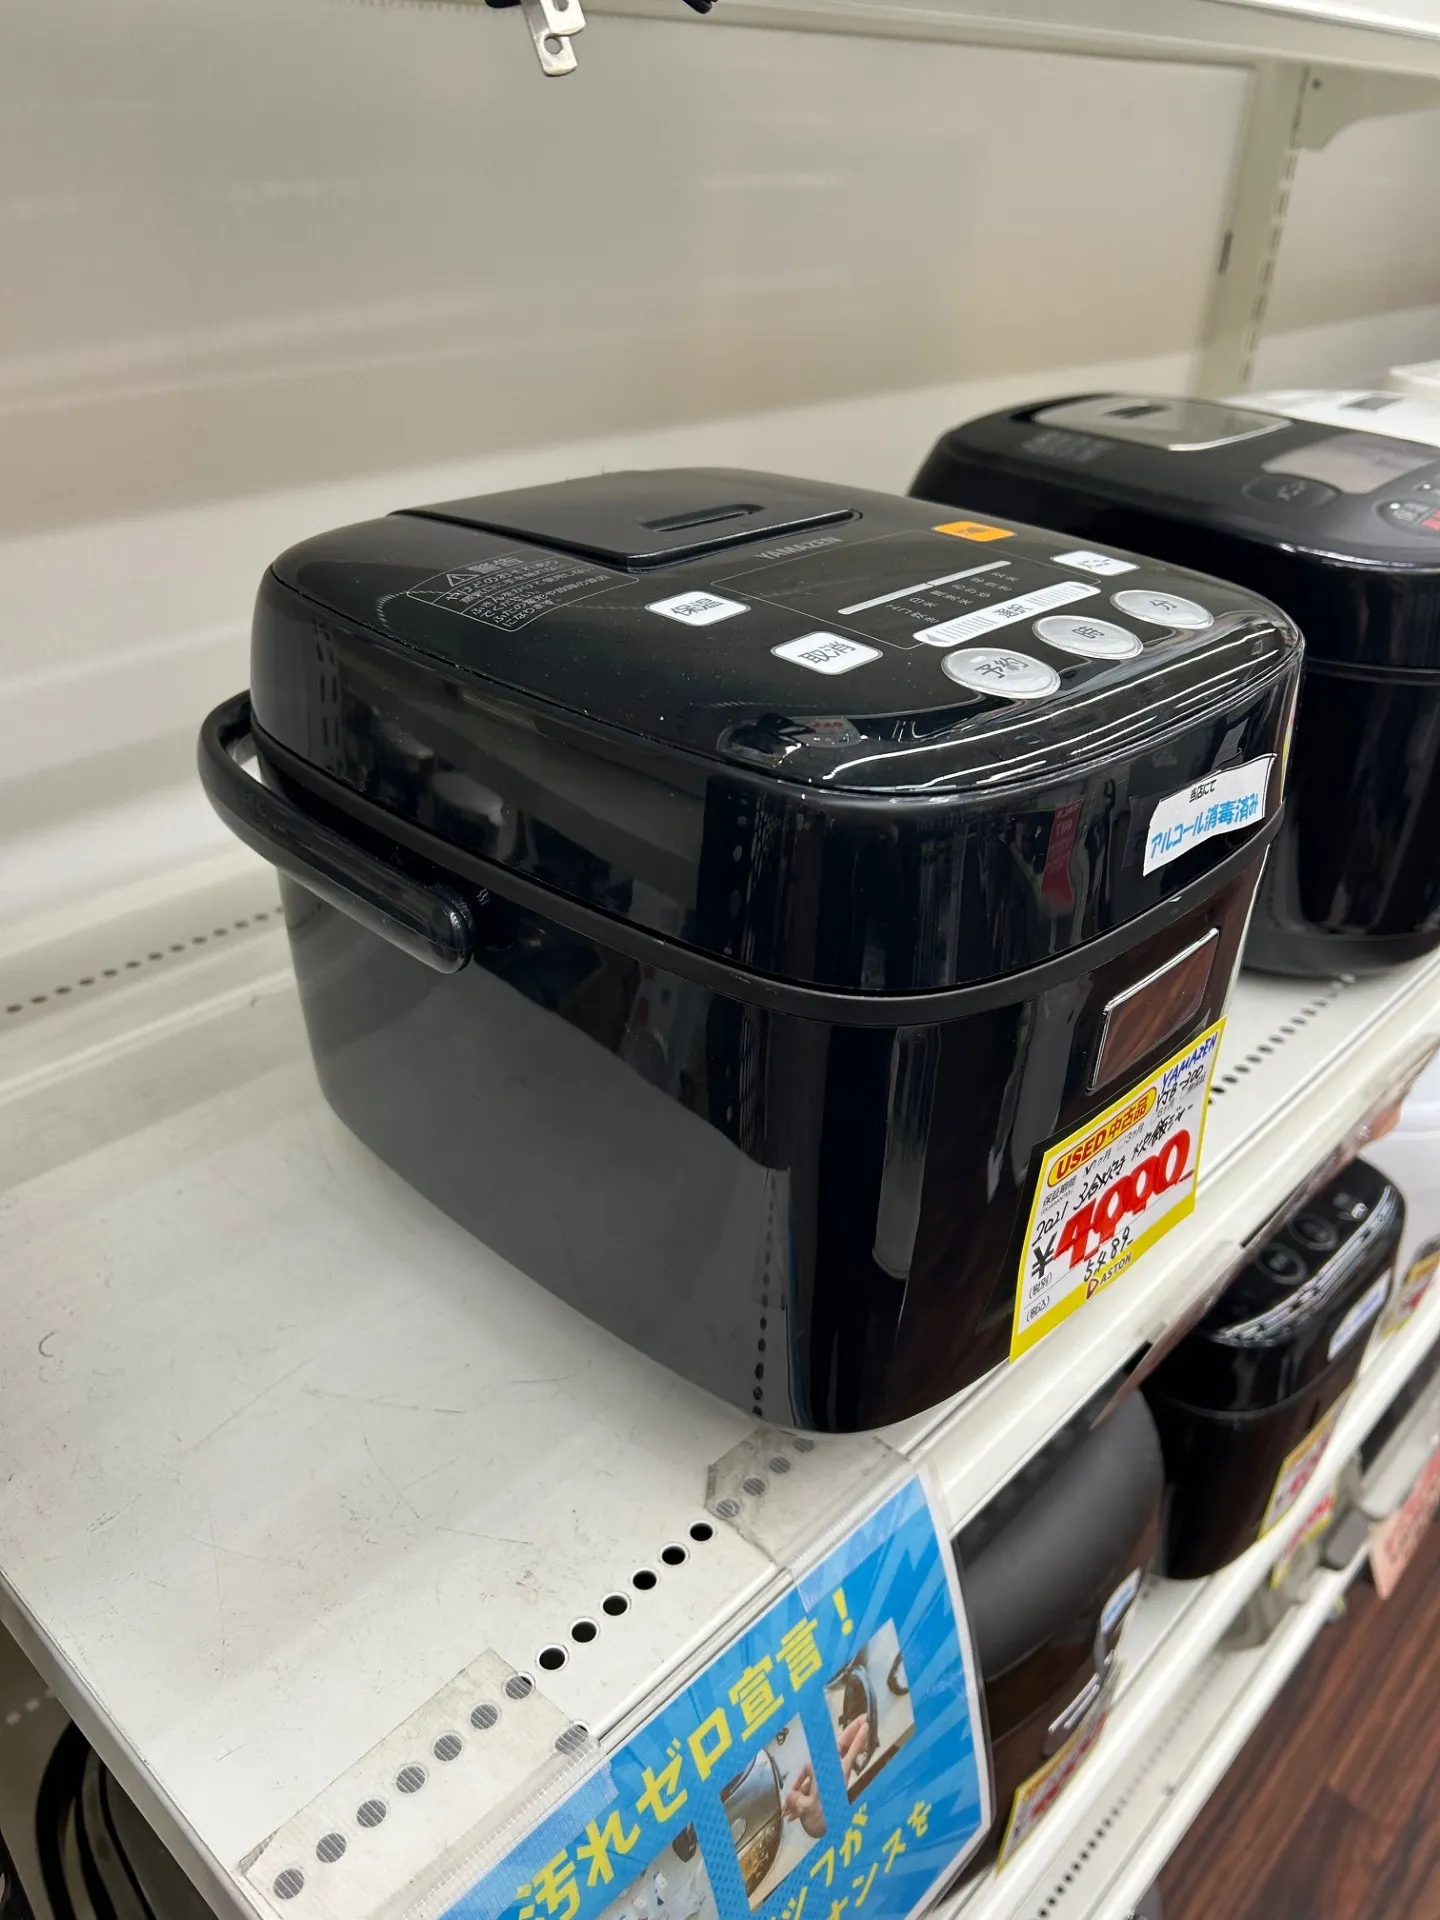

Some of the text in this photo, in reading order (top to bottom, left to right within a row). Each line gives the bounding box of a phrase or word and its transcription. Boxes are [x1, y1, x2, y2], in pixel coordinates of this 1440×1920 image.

[753, 536, 842, 560] YAMAZEN
[670, 597, 725, 616] 保温
[992, 603, 1033, 620] 選択
[1149, 598, 1177, 610] 分
[1071, 624, 1105, 640] 時
[798, 641, 858, 664] 取消
[974, 656, 1030, 679] 予約
[1189, 779, 1217, 803] 当店にて
[1151, 793, 1259, 859] アルコール消毒済み
[1161, 1030, 1218, 1094] YAMAZEN
[1056, 1094, 1149, 1180] USED 中古品
[1031, 1201, 1069, 1247] 2021
[515, 1588, 855, 1920] 汚れゼロ宣言！
